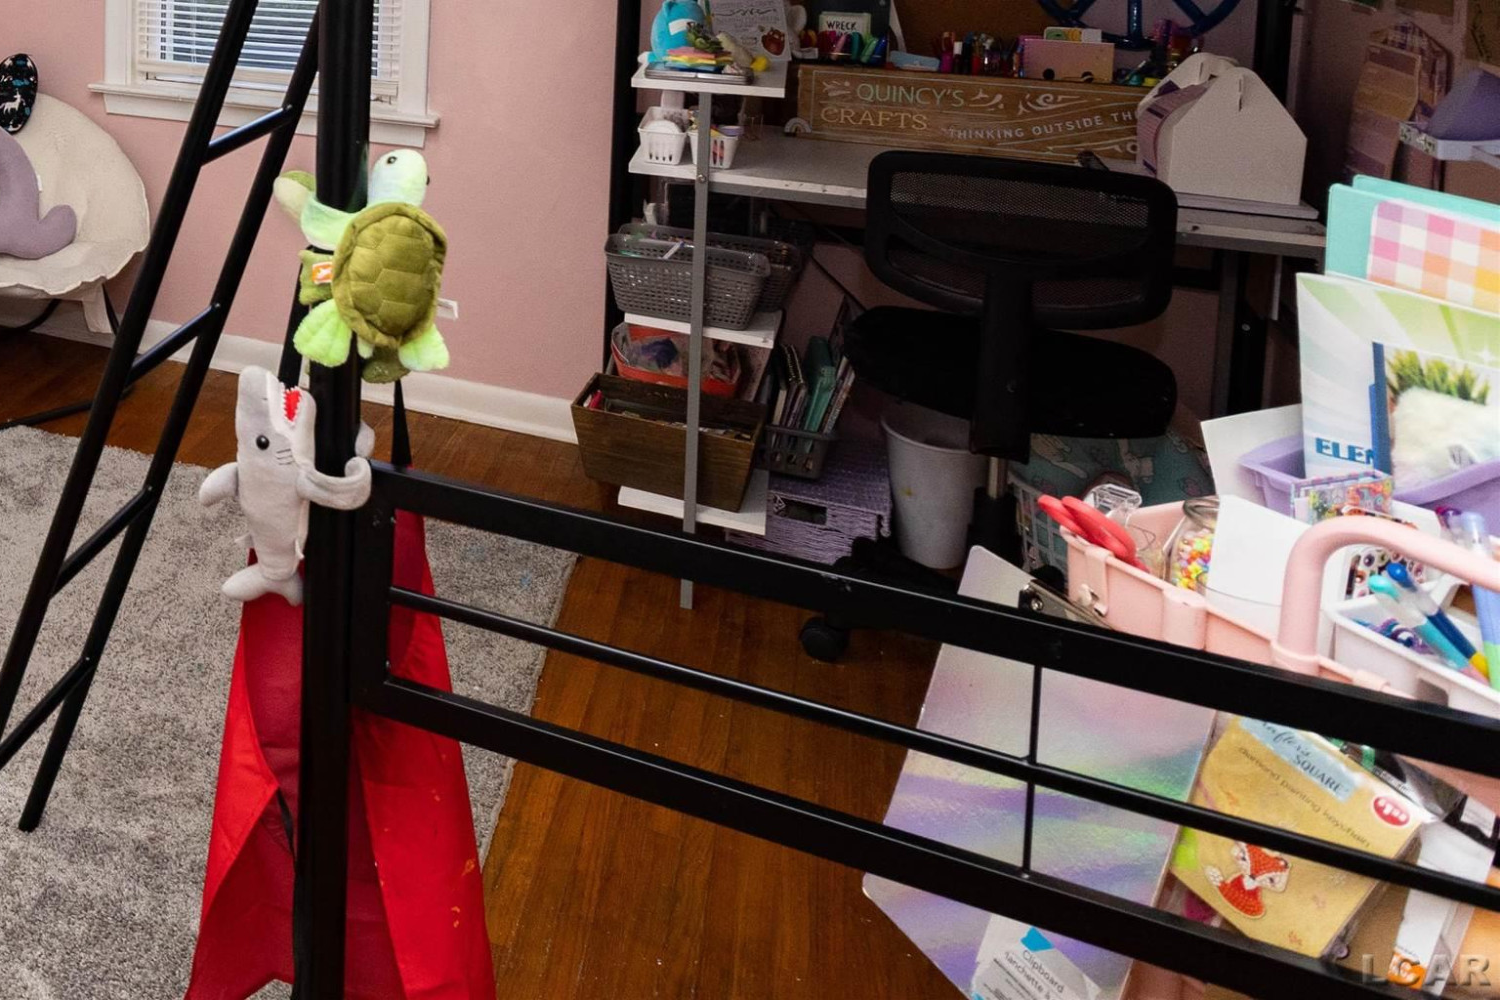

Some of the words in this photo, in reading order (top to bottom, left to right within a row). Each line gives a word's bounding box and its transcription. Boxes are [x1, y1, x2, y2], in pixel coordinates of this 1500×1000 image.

[826, 20, 857, 31] WRECK
[856, 83, 965, 108] QUINCY'S
[820, 107, 927, 131] CRAFTS
[950, 127, 1024, 140] THINKING
[1032, 115, 1103, 136] OUTSIDE
[1111, 110, 1138, 123] TH
[1292, 754, 1345, 794] SQUARE
[1279, 780, 1321, 813] painting
[1005, 951, 1044, 993] lanchette
[1022, 949, 1065, 993] Clipboard
